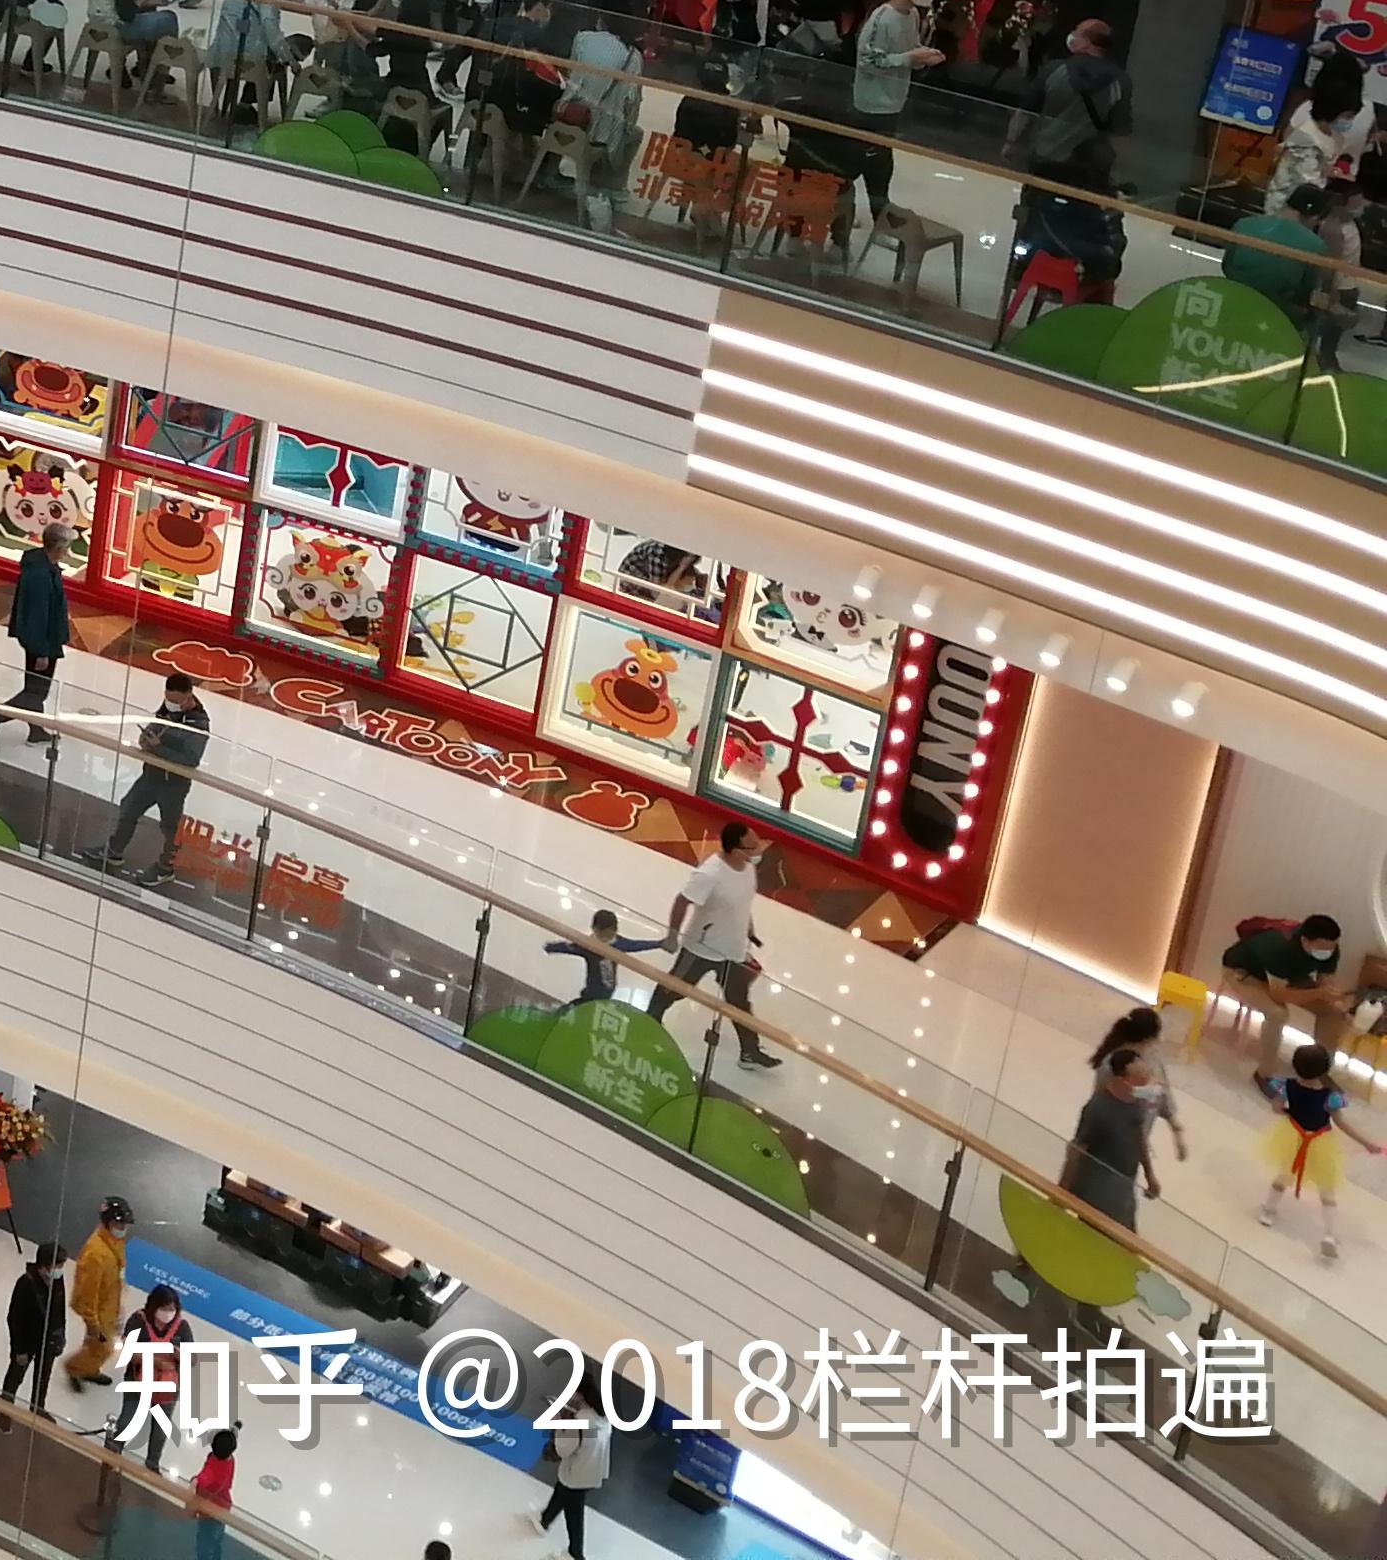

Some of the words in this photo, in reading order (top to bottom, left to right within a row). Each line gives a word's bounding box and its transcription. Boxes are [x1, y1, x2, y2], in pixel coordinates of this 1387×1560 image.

[1174, 281, 1223, 328] 向
[271, 677, 567, 789] CARTOONY
[592, 1002, 630, 1043] 向
[583, 1060, 644, 1114] 新生
[588, 1033, 679, 1096] YOUNG
